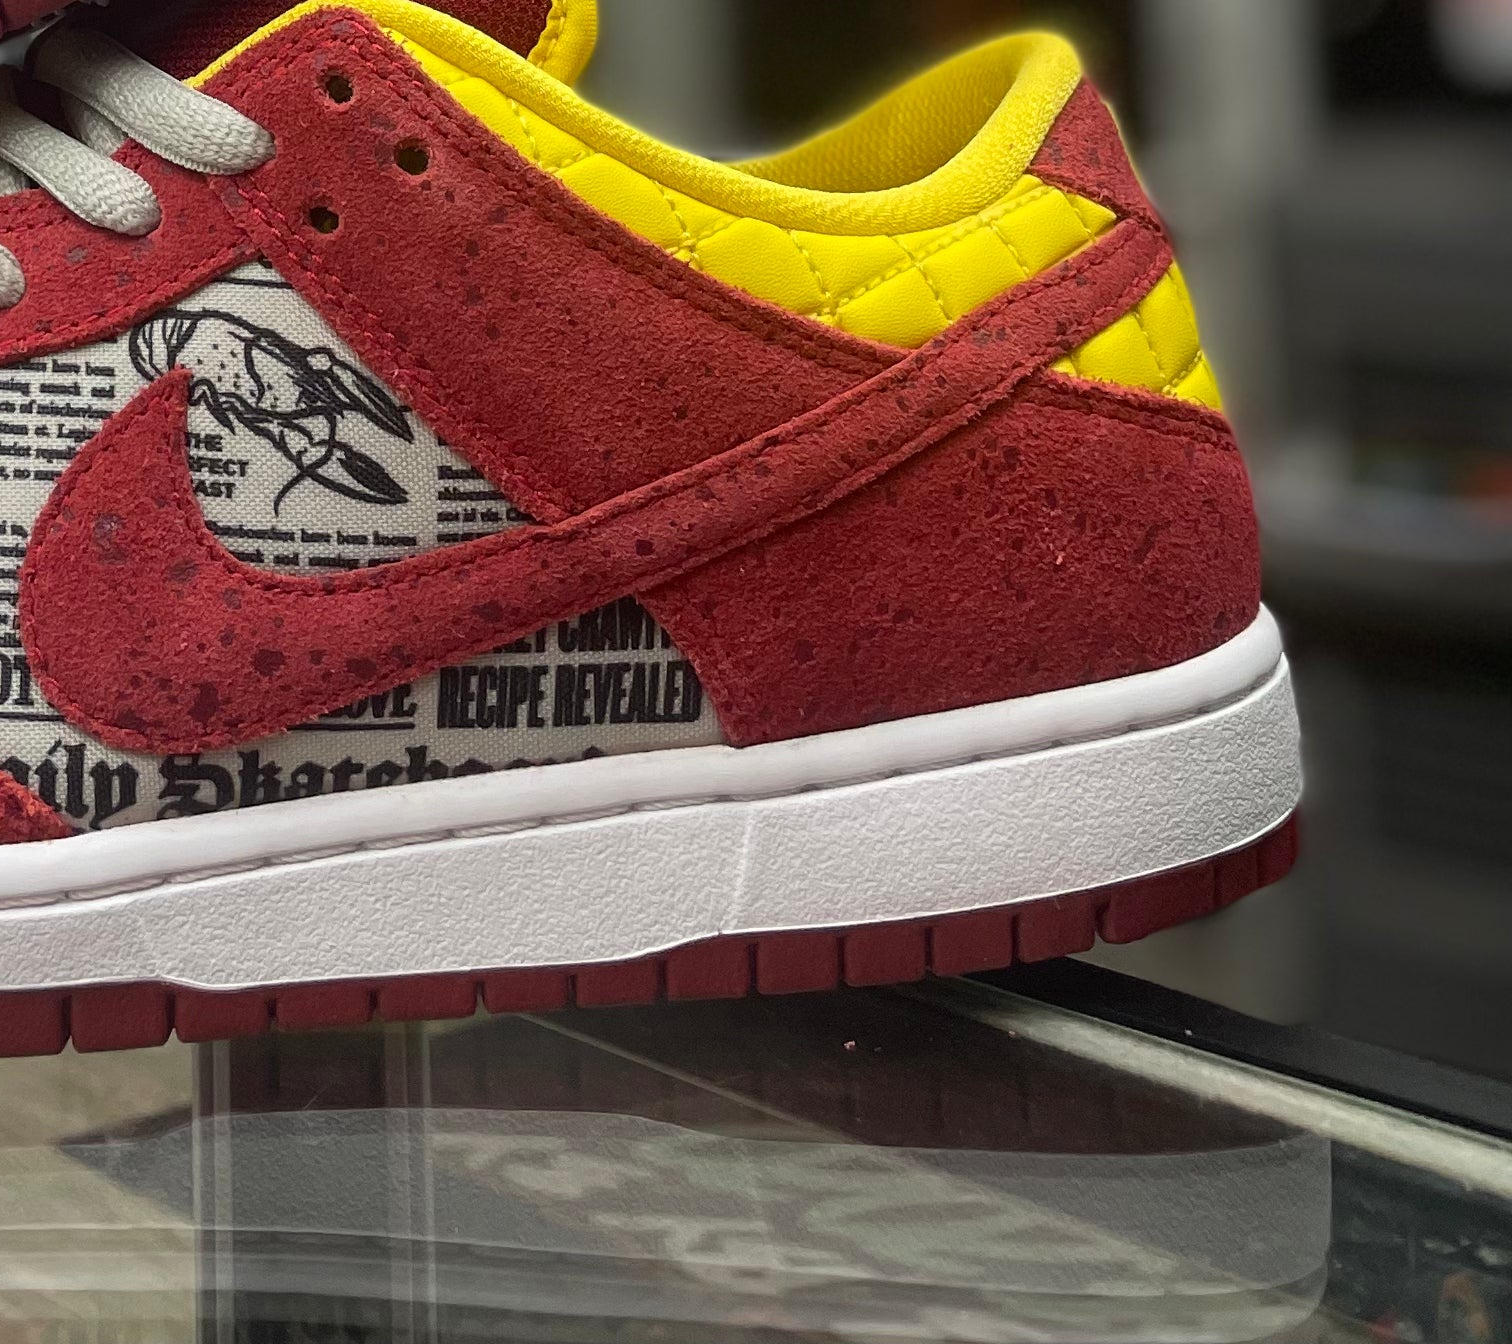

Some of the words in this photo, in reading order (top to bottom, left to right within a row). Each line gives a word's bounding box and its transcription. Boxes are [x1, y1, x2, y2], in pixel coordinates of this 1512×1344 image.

[191, 482, 236, 499] AST
[436, 665, 545, 730] RECIPE
[552, 659, 702, 728] REVEALED
